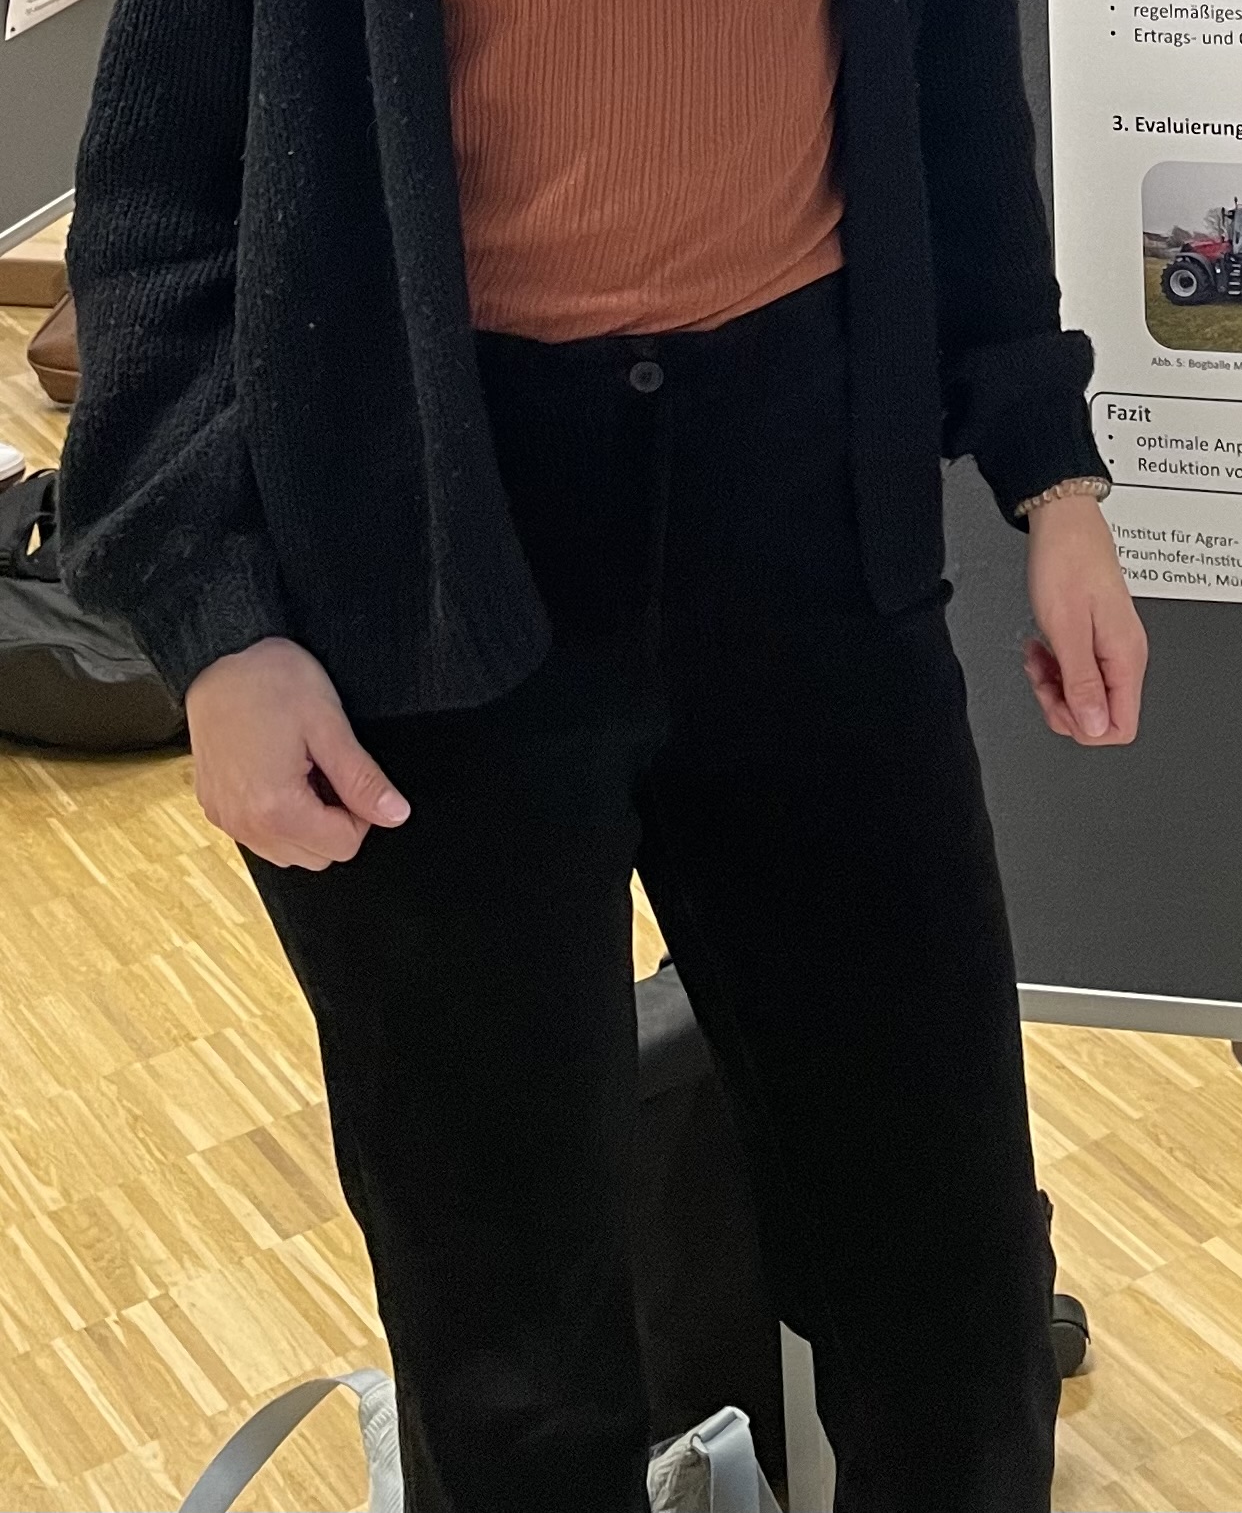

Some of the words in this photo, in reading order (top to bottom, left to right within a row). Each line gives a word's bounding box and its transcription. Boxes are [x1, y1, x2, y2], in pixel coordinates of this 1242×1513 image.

[1112, 114, 1129, 132] 3.
[1106, 403, 1152, 423] Fazit
[1136, 434, 1209, 452] optimale
[1134, 457, 1221, 477] Reduktion
[1162, 570, 1211, 588] GmbH,
